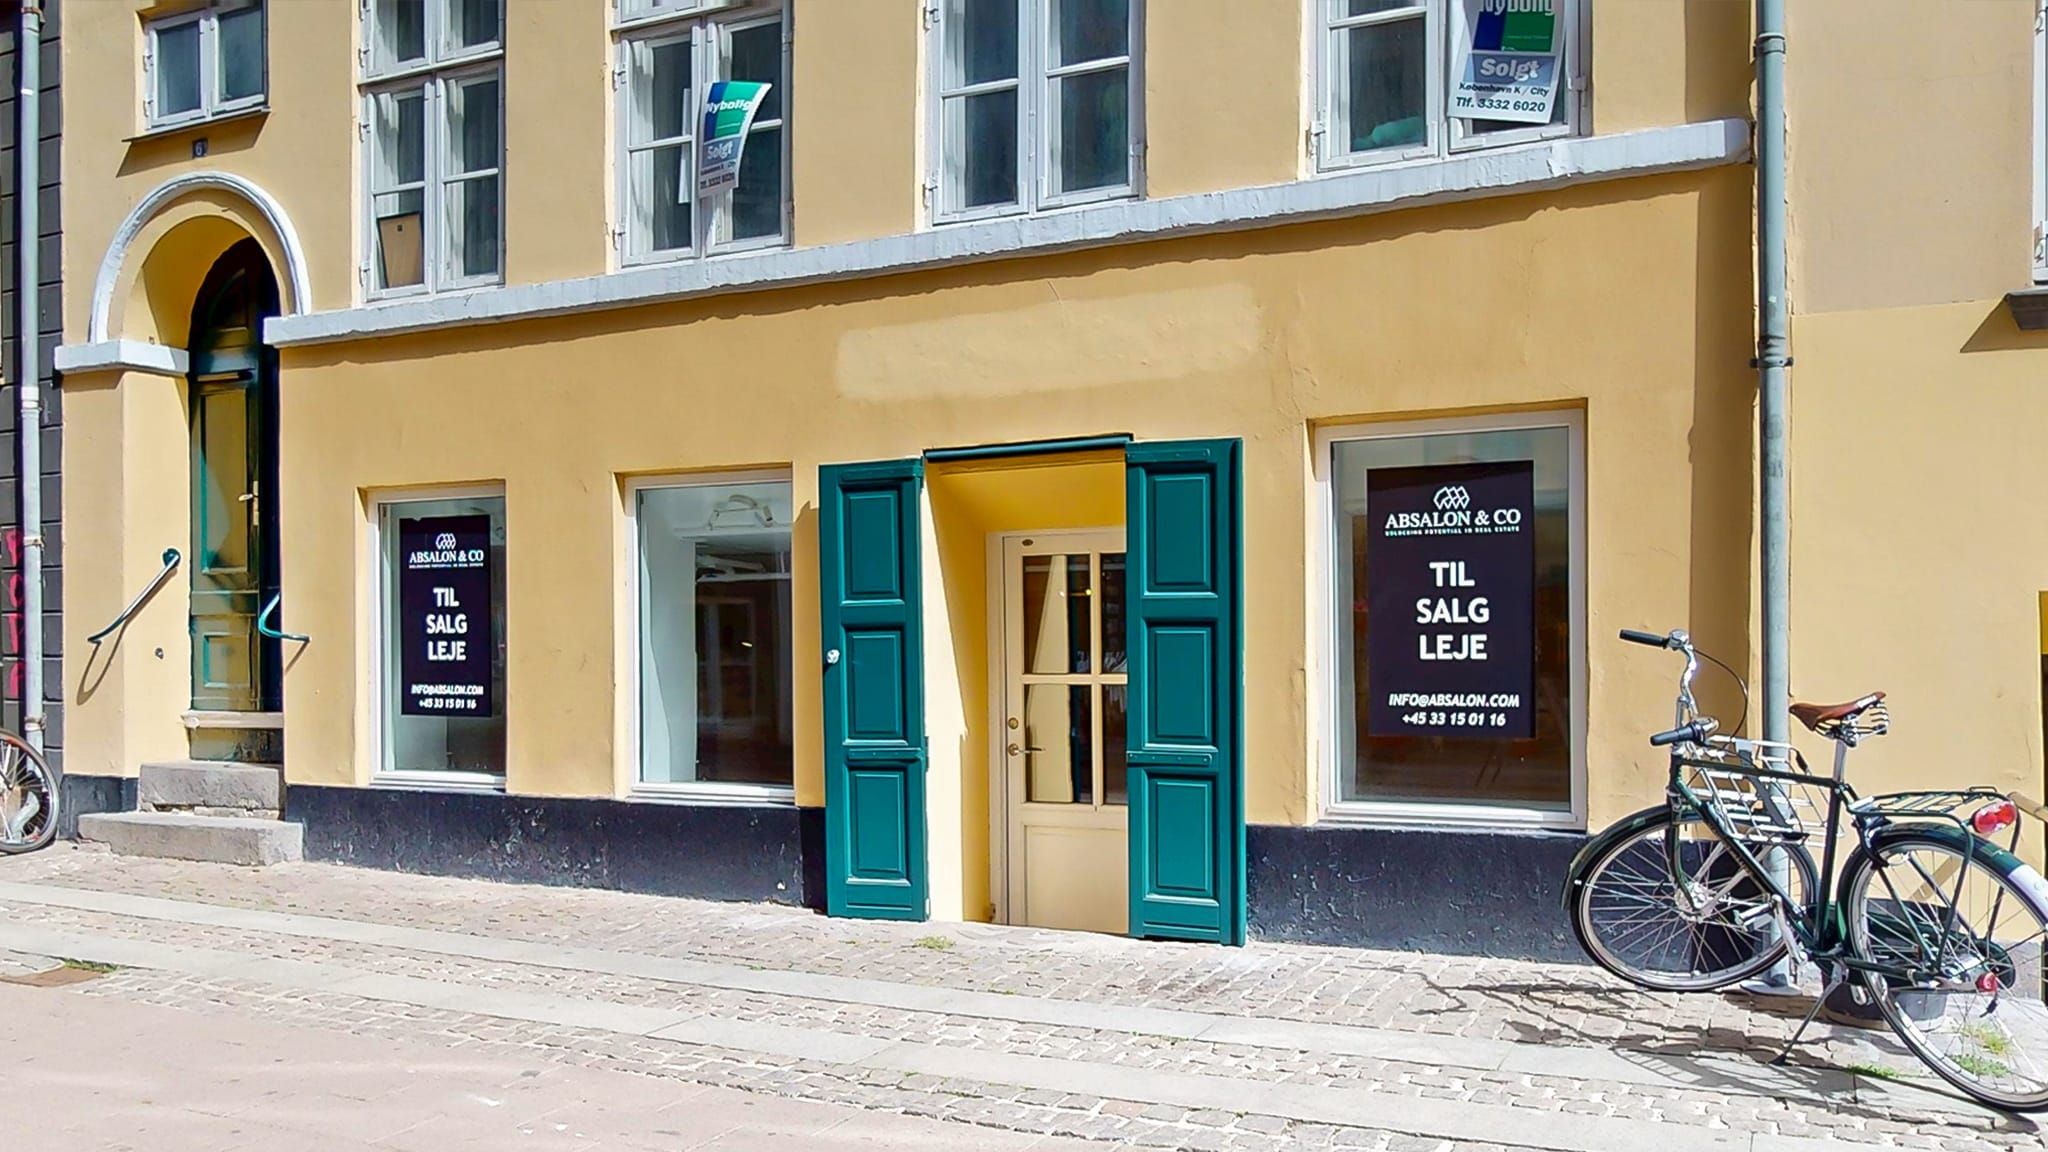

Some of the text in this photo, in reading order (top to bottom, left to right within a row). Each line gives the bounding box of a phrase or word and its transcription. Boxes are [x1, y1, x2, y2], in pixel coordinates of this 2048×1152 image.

[1480, 58, 1540, 81] Solgt
[1459, 82, 1512, 93] København
[1530, 87, 1549, 97] City
[1456, 97, 1546, 112] Tlf. 3332 6020
[707, 140, 733, 159] Solgt
[1385, 508, 1521, 529] ABSALON & CO
[409, 549, 484, 563] ABSALON & CO
[1429, 561, 1475, 587] TIL
[433, 587, 460, 607] TIL
[1416, 597, 1490, 624] SALG
[426, 614, 468, 634] SALG
[428, 641, 467, 661] LEJE
[1419, 634, 1487, 660] LEJE
[411, 684, 484, 695] INFO@ABSALON.COM
[419, 698, 433, 708] +45
[445, 698, 454, 709] 15
[455, 698, 464, 709] 01
[466, 699, 477, 709] 16
[1388, 694, 1520, 708] INFO@ABSALON.COM
[1402, 712, 1506, 727] +45 33 15 01 16
